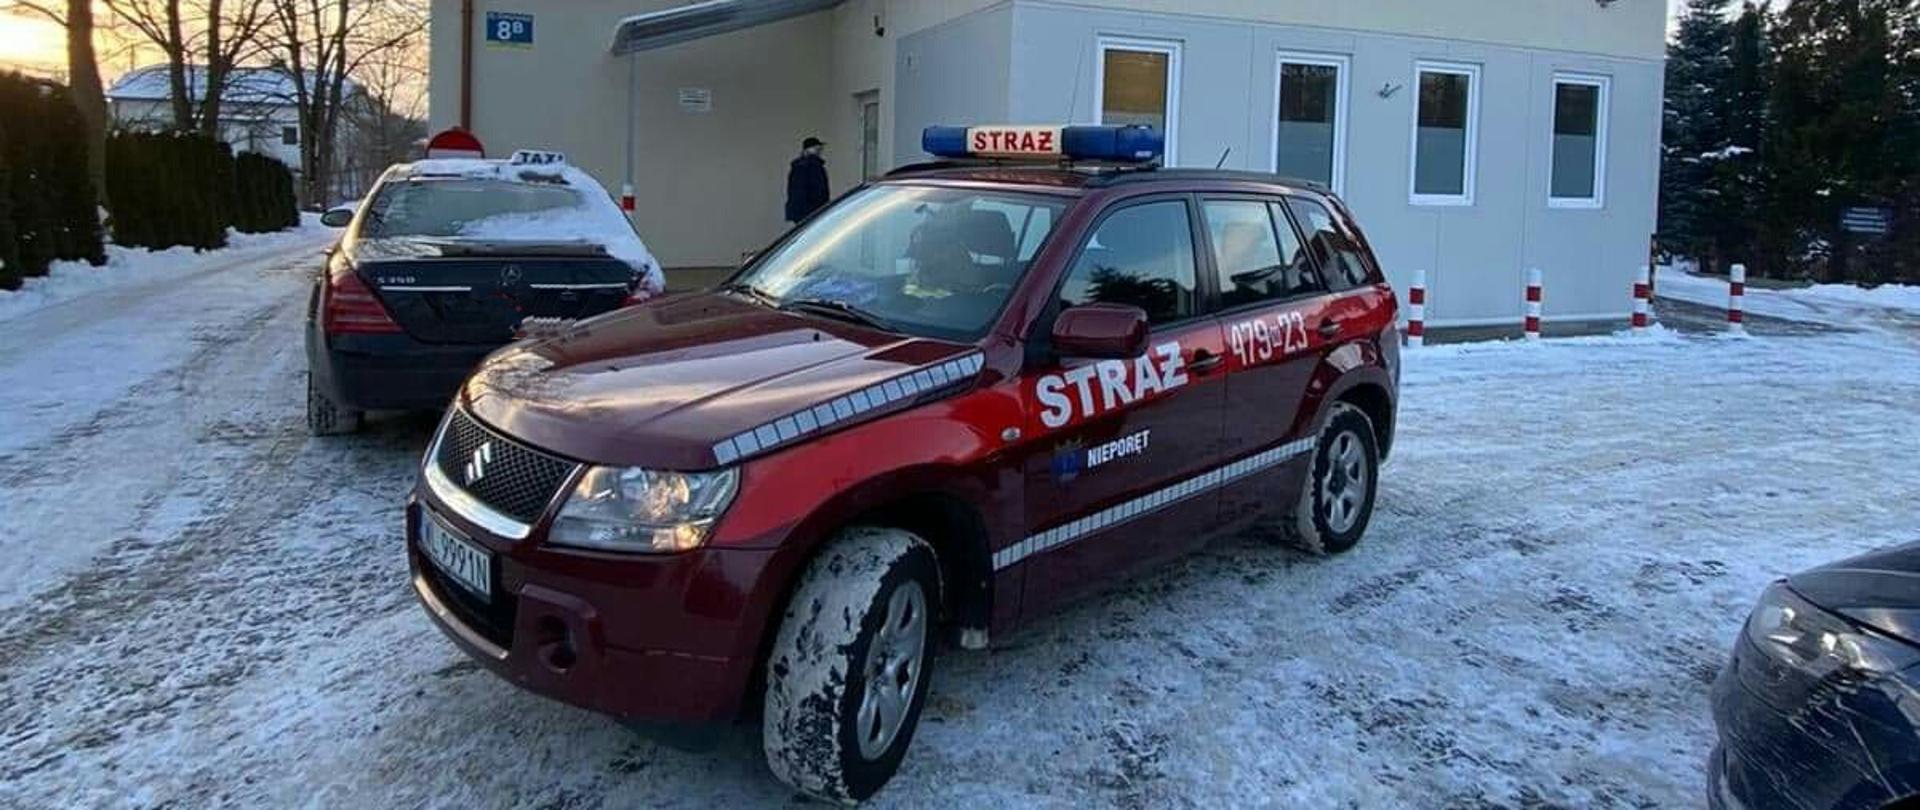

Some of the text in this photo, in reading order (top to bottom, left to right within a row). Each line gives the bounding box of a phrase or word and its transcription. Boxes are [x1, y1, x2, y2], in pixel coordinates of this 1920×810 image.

[497, 20, 524, 40] 8B
[974, 131, 1053, 151] STRAŻ
[520, 152, 563, 165] TAXI
[1036, 341, 1189, 427] STRAŻ
[1087, 430, 1150, 468] NIEPORĘT
